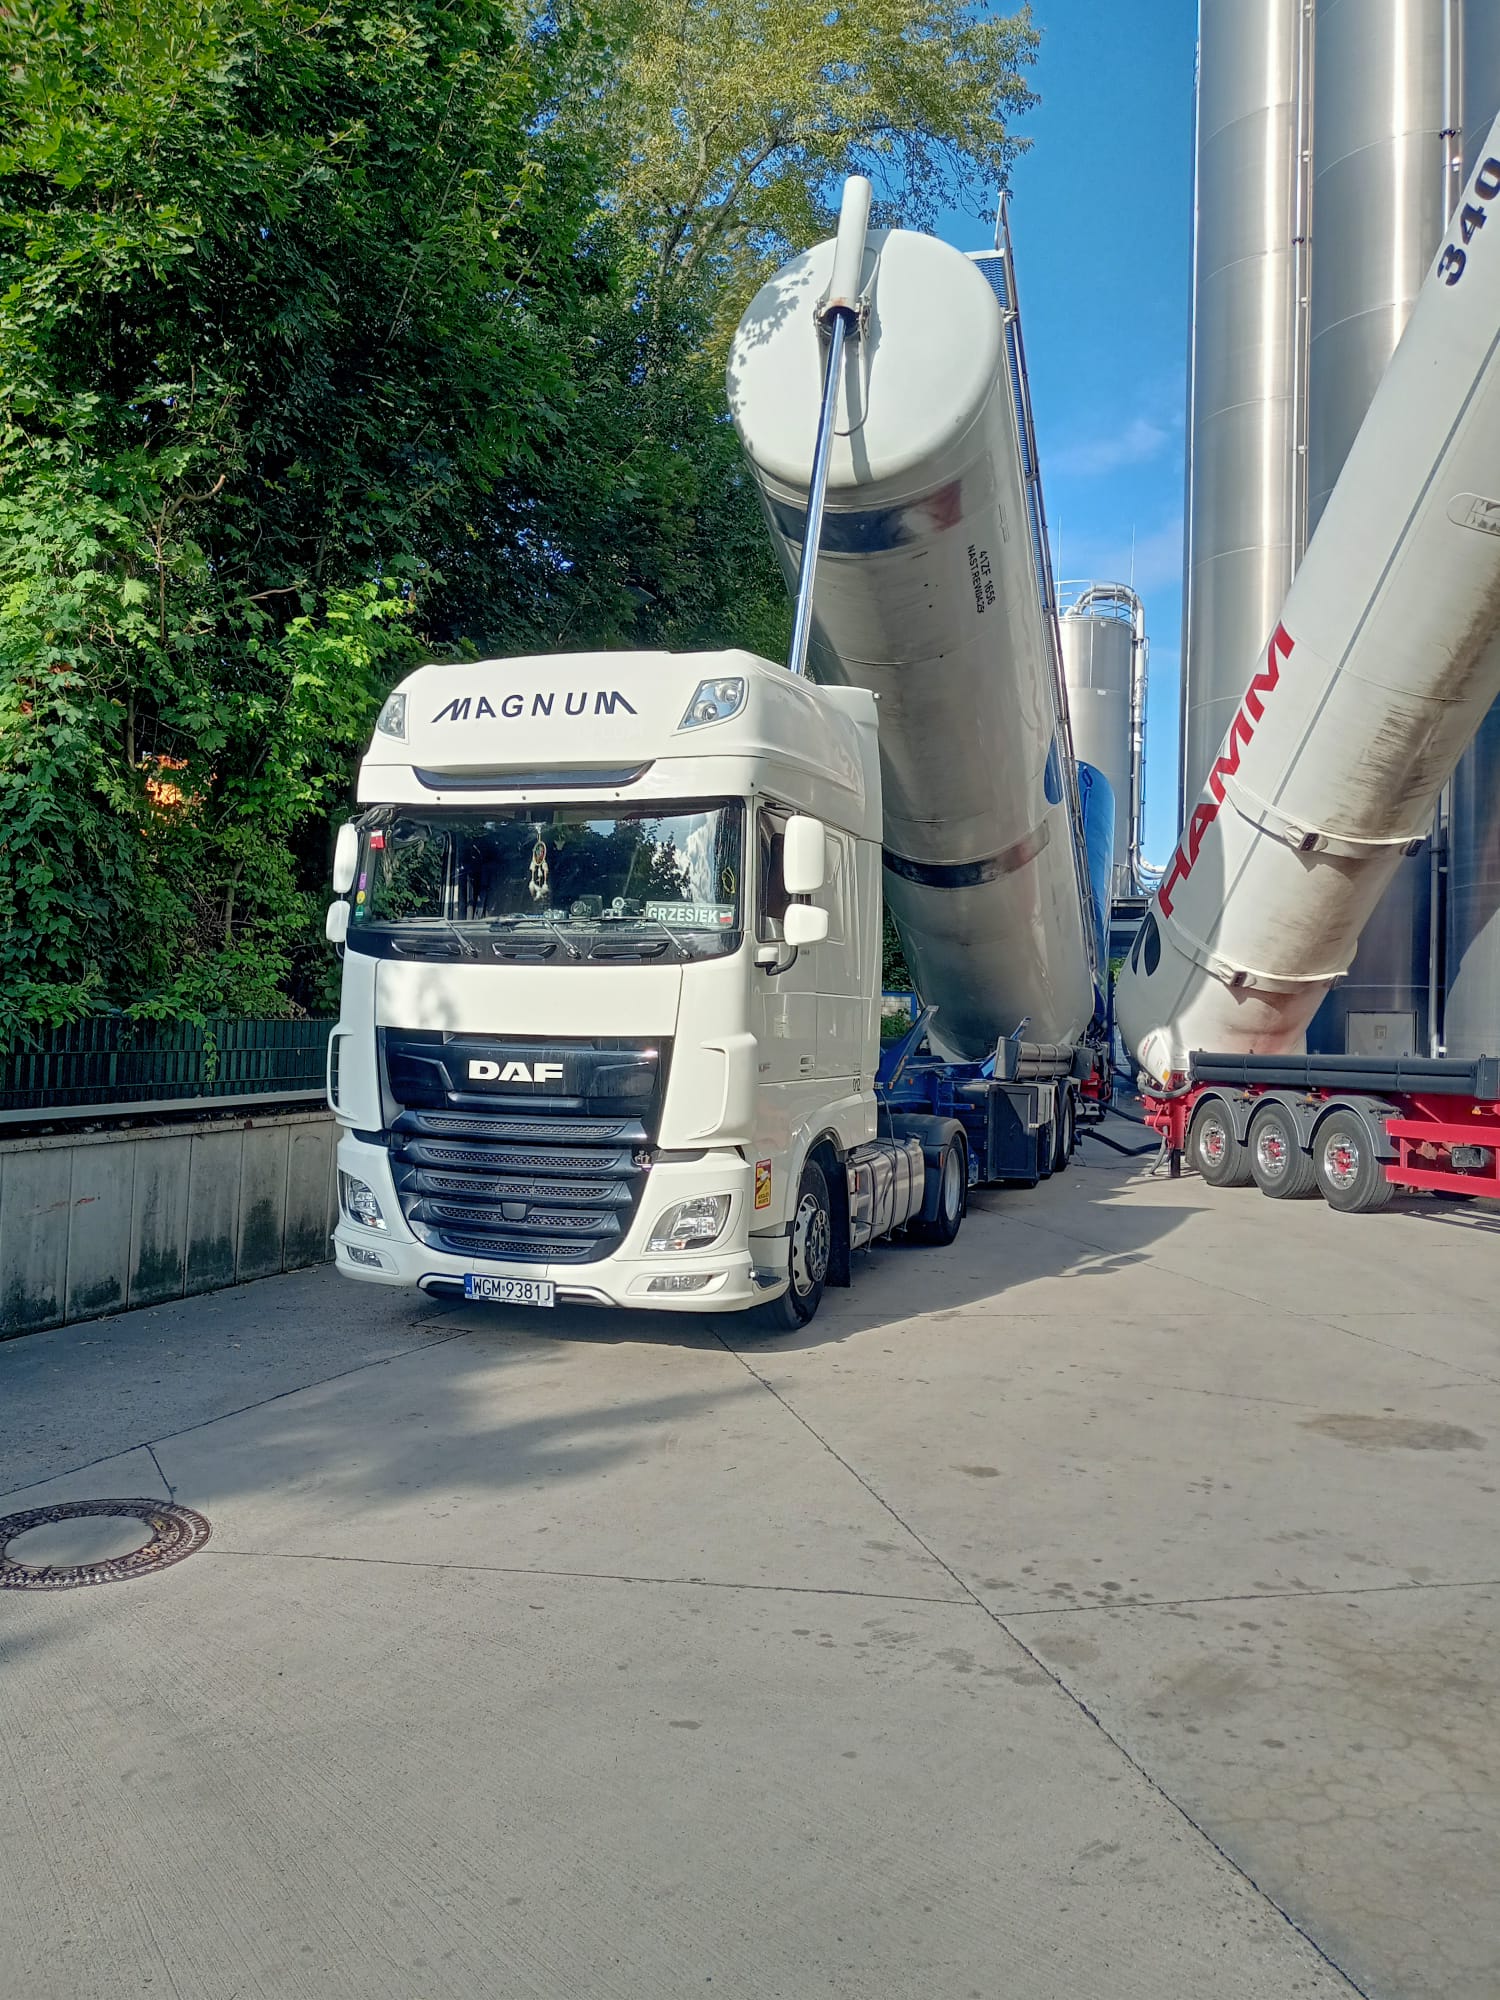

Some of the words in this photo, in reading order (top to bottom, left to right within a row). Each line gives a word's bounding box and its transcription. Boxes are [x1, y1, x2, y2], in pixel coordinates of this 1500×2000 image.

[430, 691, 638, 724] MAGNUM
[647, 907, 718, 923] GRZESIEK
[468, 1060, 563, 1083] DAF
[472, 1277, 501, 1297] WGM
[505, 1281, 551, 1301] 9381J
